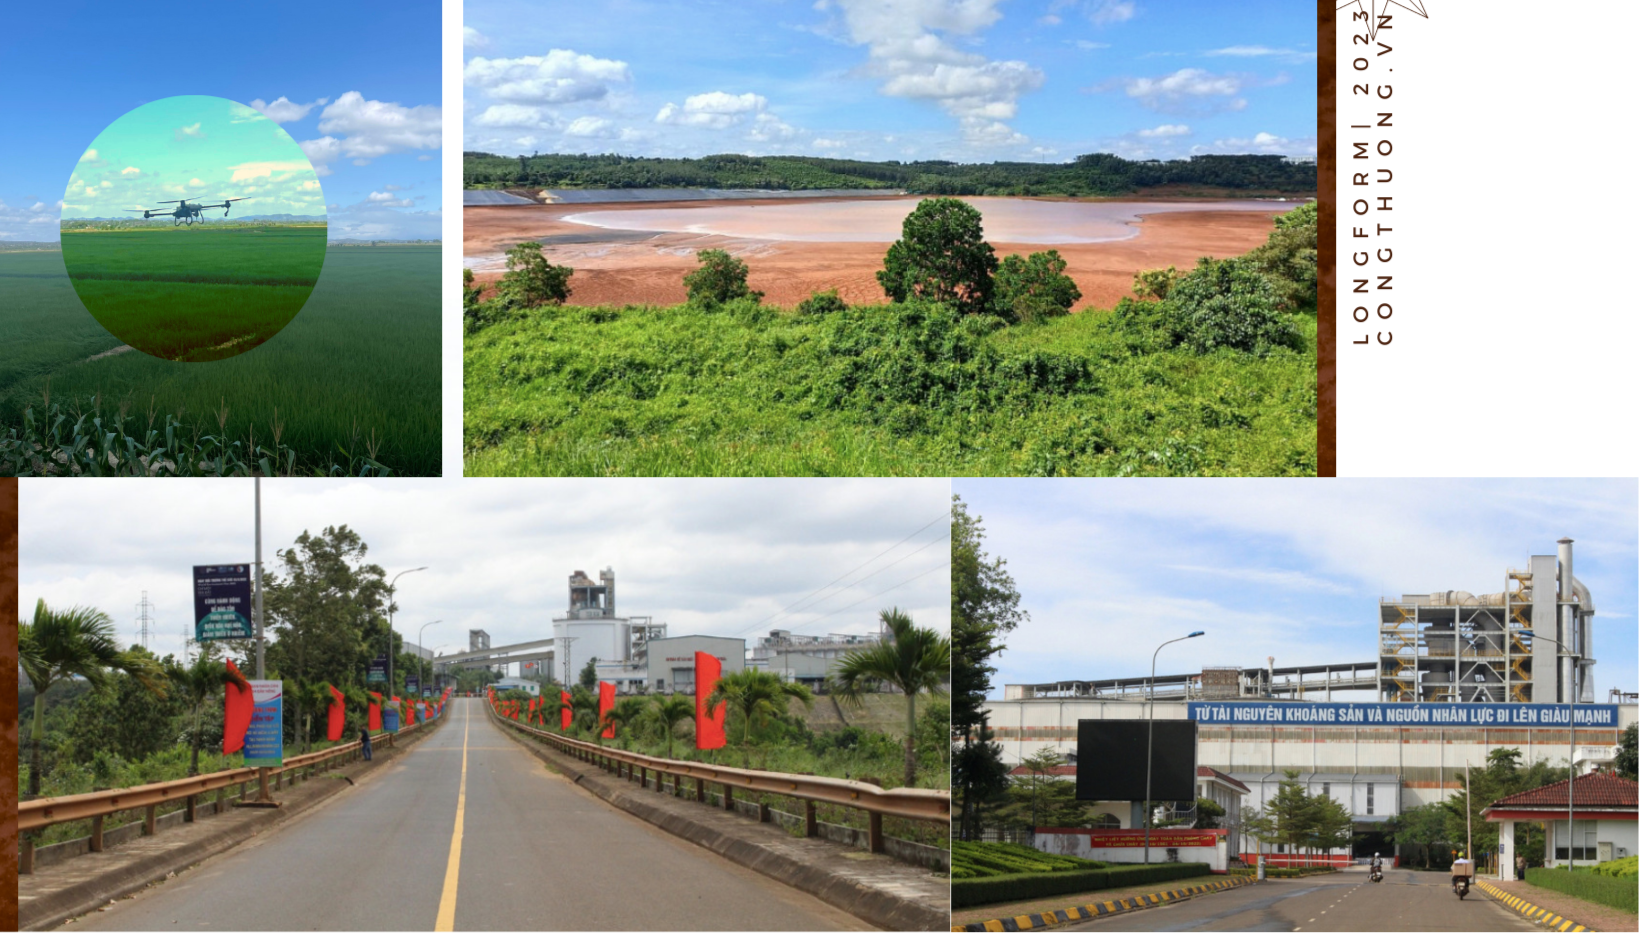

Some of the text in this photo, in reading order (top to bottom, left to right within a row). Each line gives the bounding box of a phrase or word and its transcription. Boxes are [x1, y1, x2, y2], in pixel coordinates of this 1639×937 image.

[1195, 704, 1611, 725] TỪ TÀI NGUYÊN KHOÁNG SẢN VÀ NGUỒN NHÂN LỰC ĐI LÊN GIÀU MẠNH
